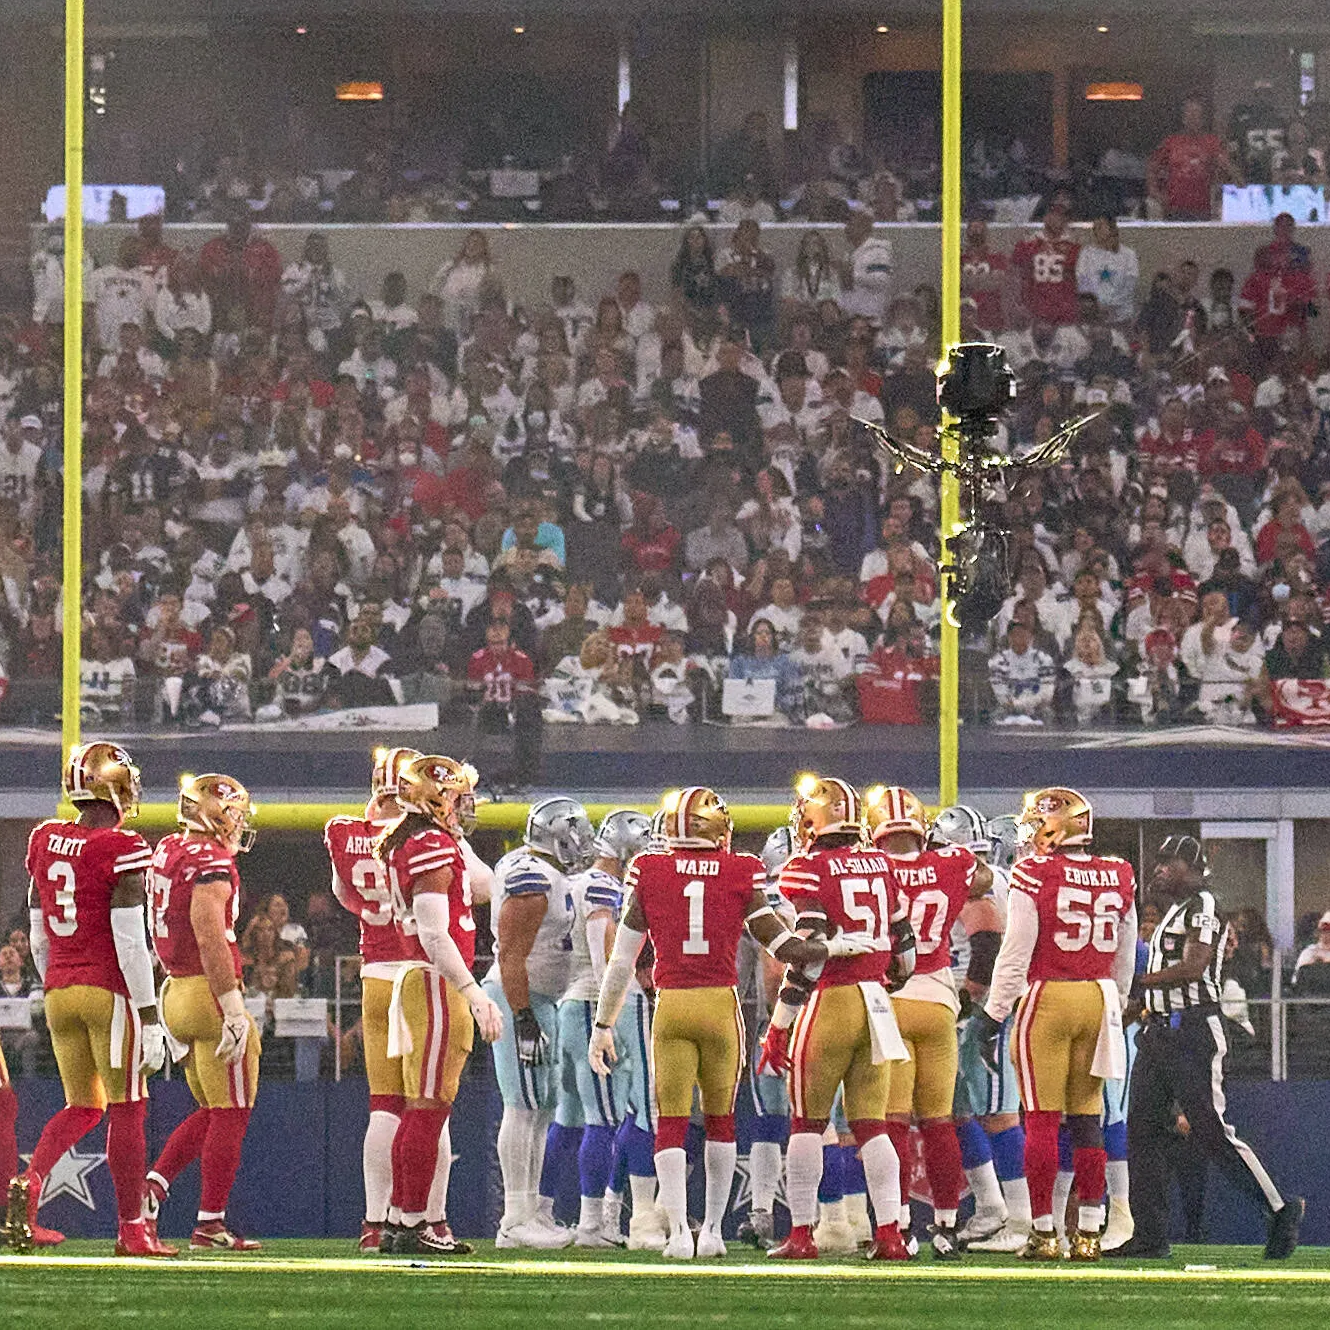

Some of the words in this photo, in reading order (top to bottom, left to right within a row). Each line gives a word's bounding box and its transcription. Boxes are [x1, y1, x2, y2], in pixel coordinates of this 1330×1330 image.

[47, 860, 79, 938] 3
[352, 859, 392, 926] 9
[676, 859, 720, 876] WARD
[682, 879, 710, 955] 1
[839, 877, 892, 951] 51
[910, 889, 949, 955] 0
[1053, 886, 1124, 953] 56
